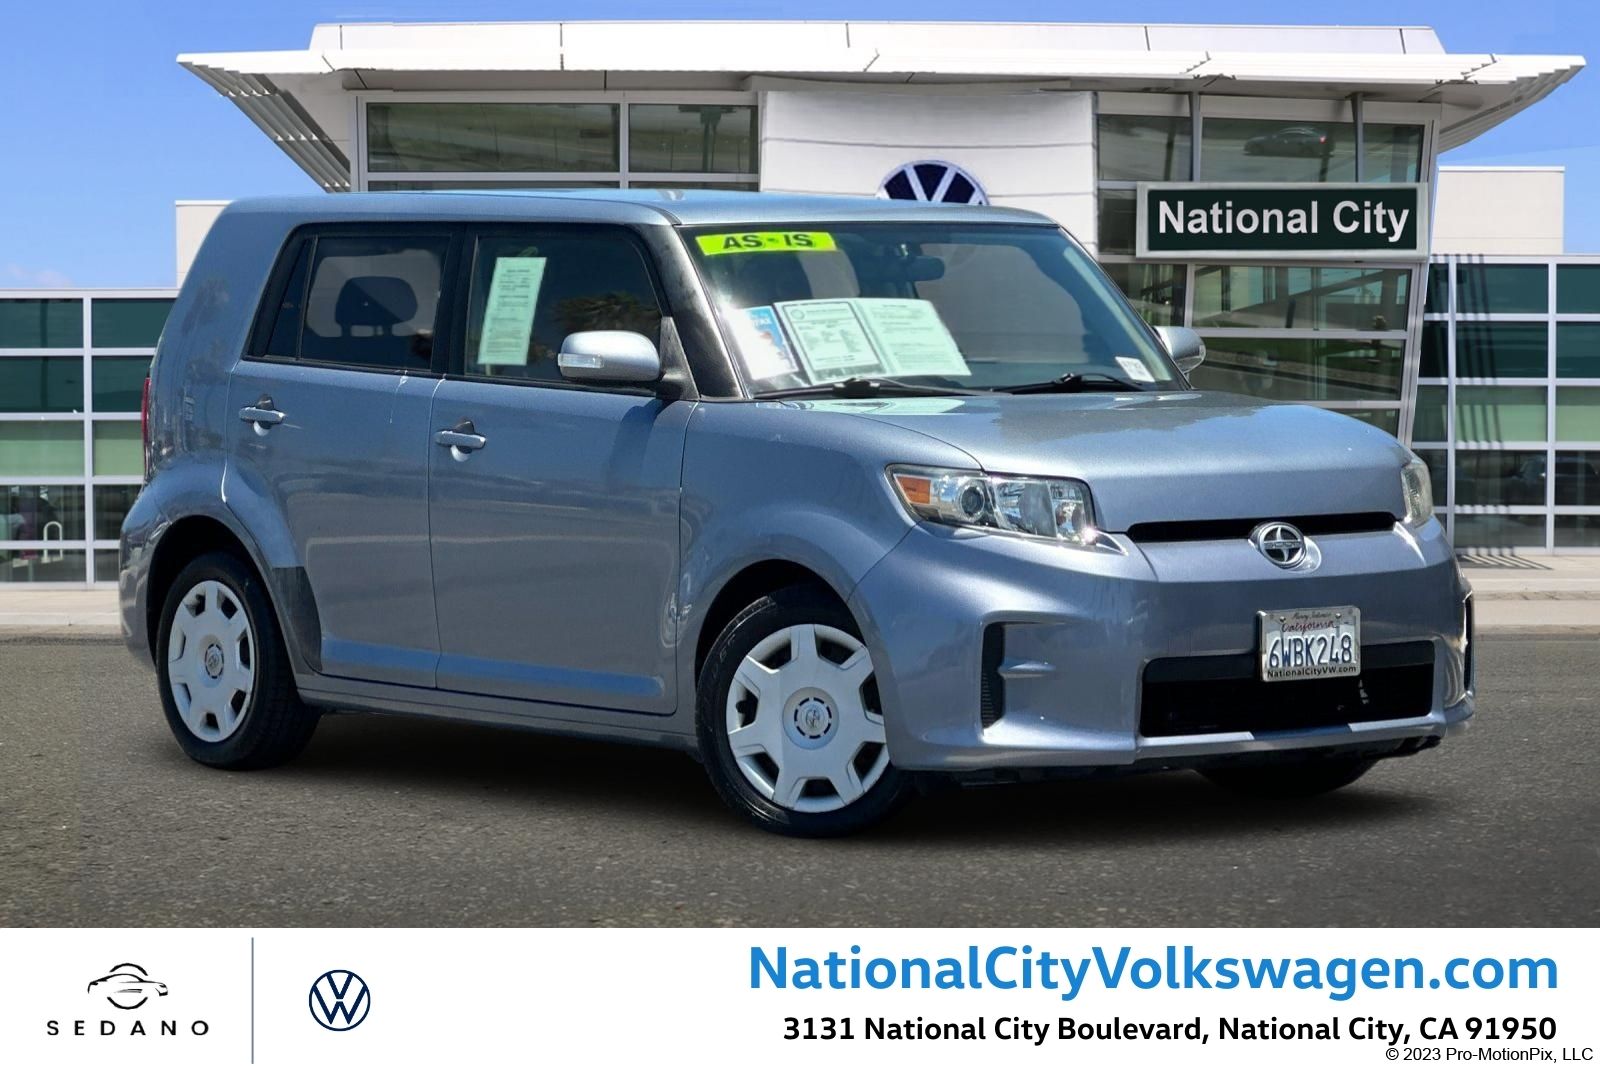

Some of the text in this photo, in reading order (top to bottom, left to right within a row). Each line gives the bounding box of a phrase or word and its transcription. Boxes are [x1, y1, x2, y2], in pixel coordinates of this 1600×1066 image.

[1157, 200, 1410, 243] National City
[1281, 621, 1338, 635] California
[1269, 635, 1353, 668] 6WBK248
[1266, 665, 1357, 679] NationalCityVW.com
